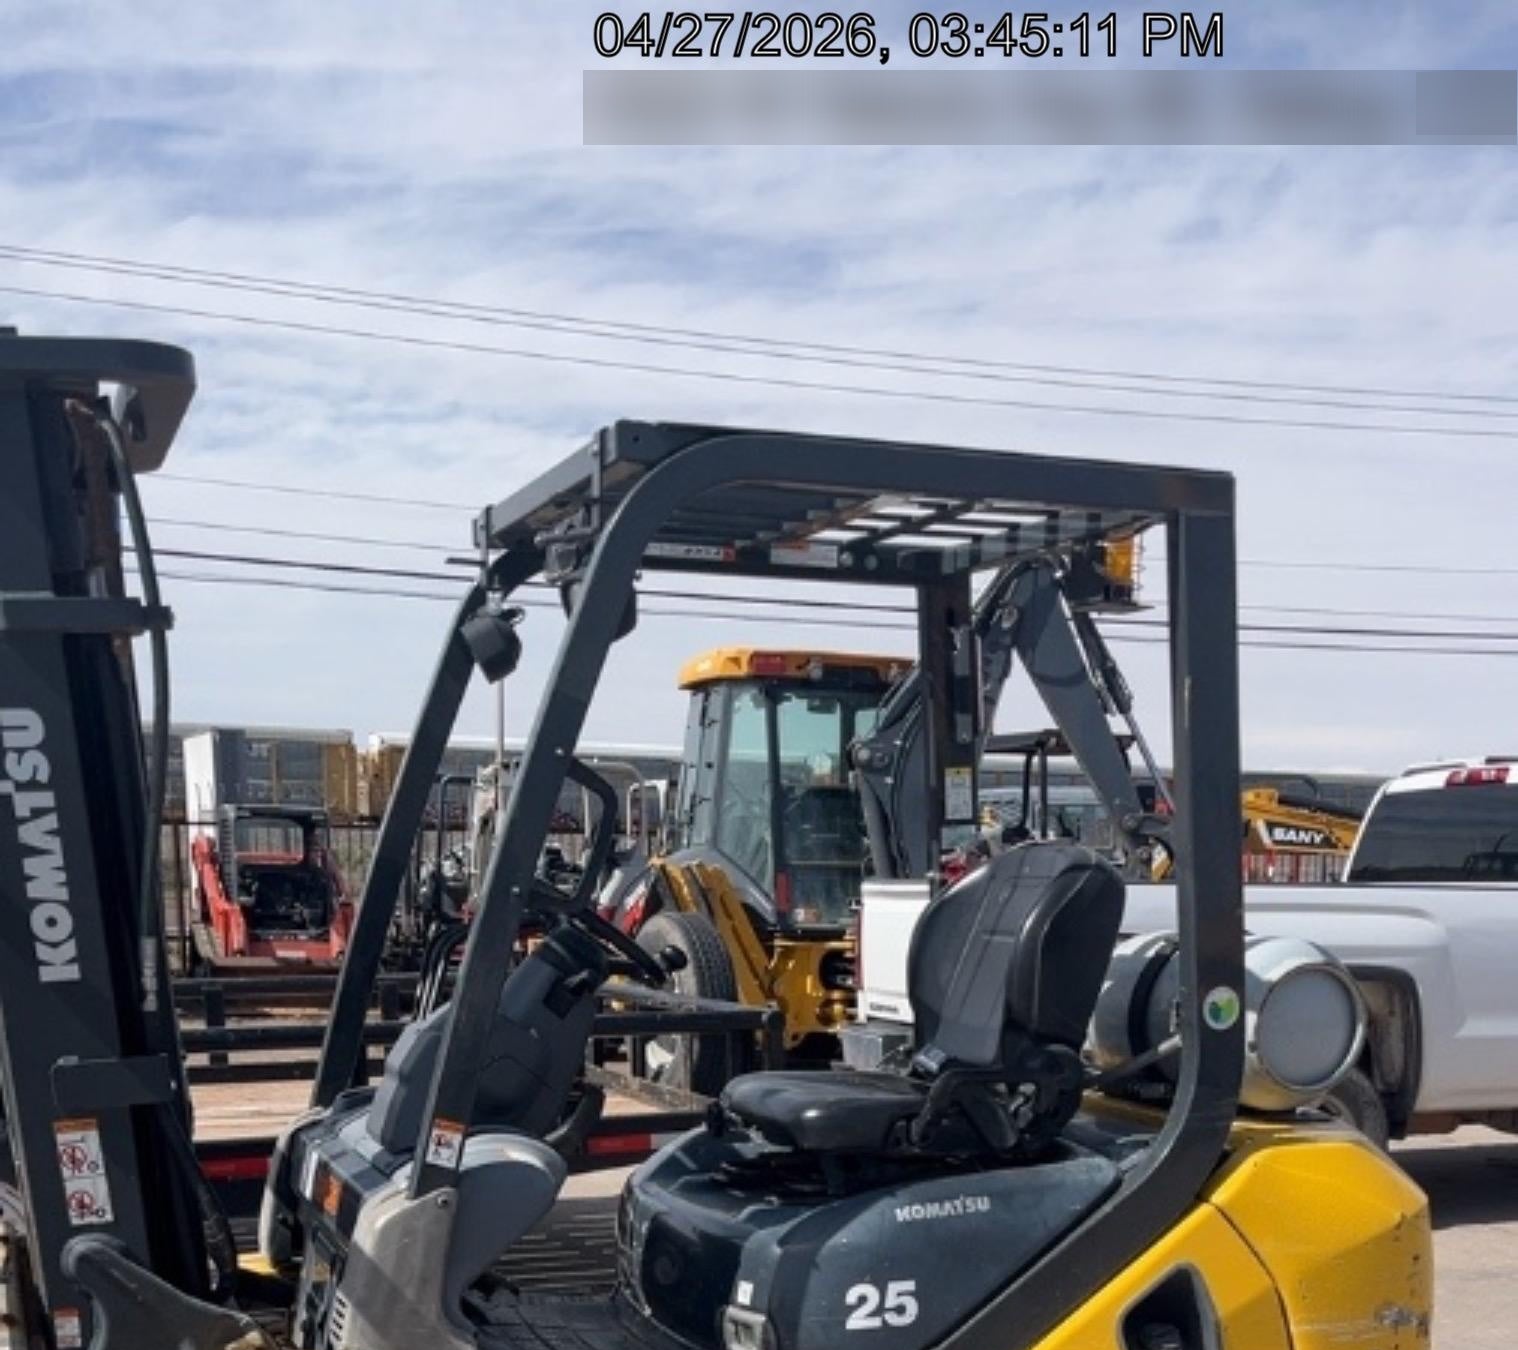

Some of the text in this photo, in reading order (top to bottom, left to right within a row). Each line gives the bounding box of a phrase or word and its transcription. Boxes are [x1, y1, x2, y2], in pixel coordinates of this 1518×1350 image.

[0, 707, 82, 983] KOMATSU
[1272, 827, 1324, 844] SANY
[894, 1195, 991, 1222] KOMATSU
[845, 1280, 919, 1330] 25
